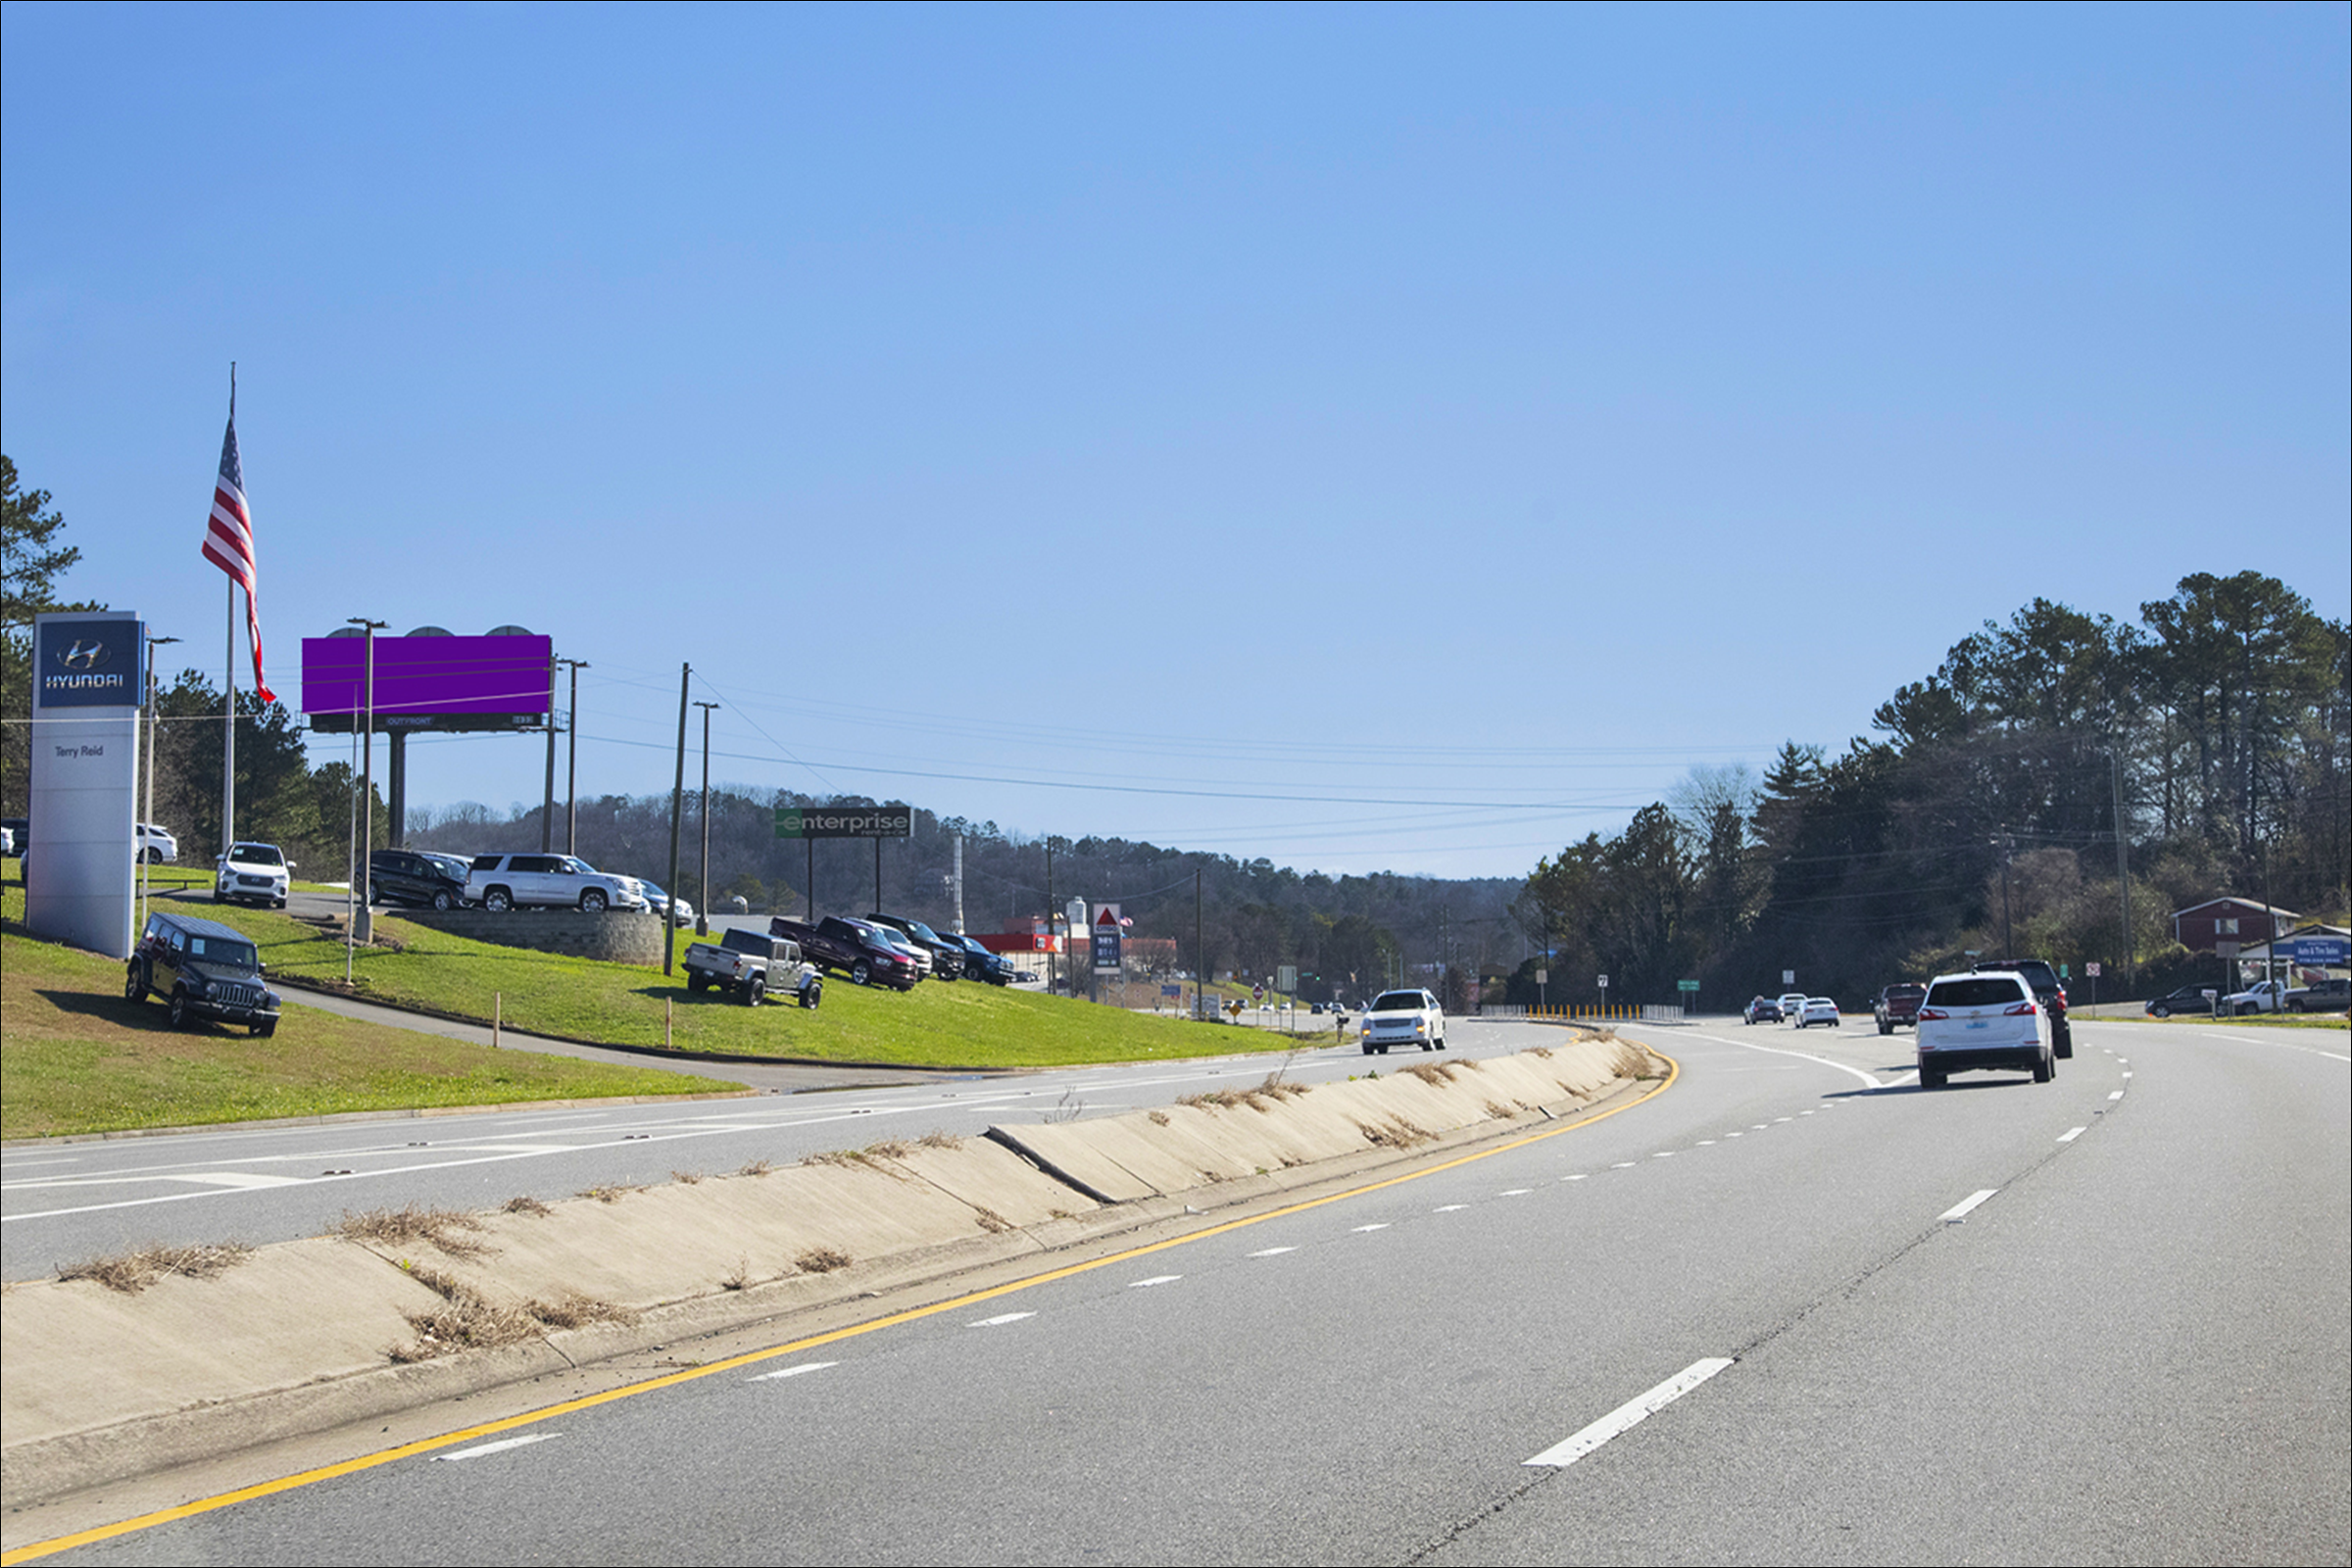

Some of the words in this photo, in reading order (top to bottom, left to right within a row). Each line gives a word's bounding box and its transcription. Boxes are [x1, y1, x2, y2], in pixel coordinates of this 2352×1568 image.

[46, 673, 123, 689] HYUNDAI
[387, 716, 431, 725] OUTFRONT
[55, 746, 78, 759] Terry
[80, 745, 104, 757] Reid
[783, 812, 908, 833] enterprise
